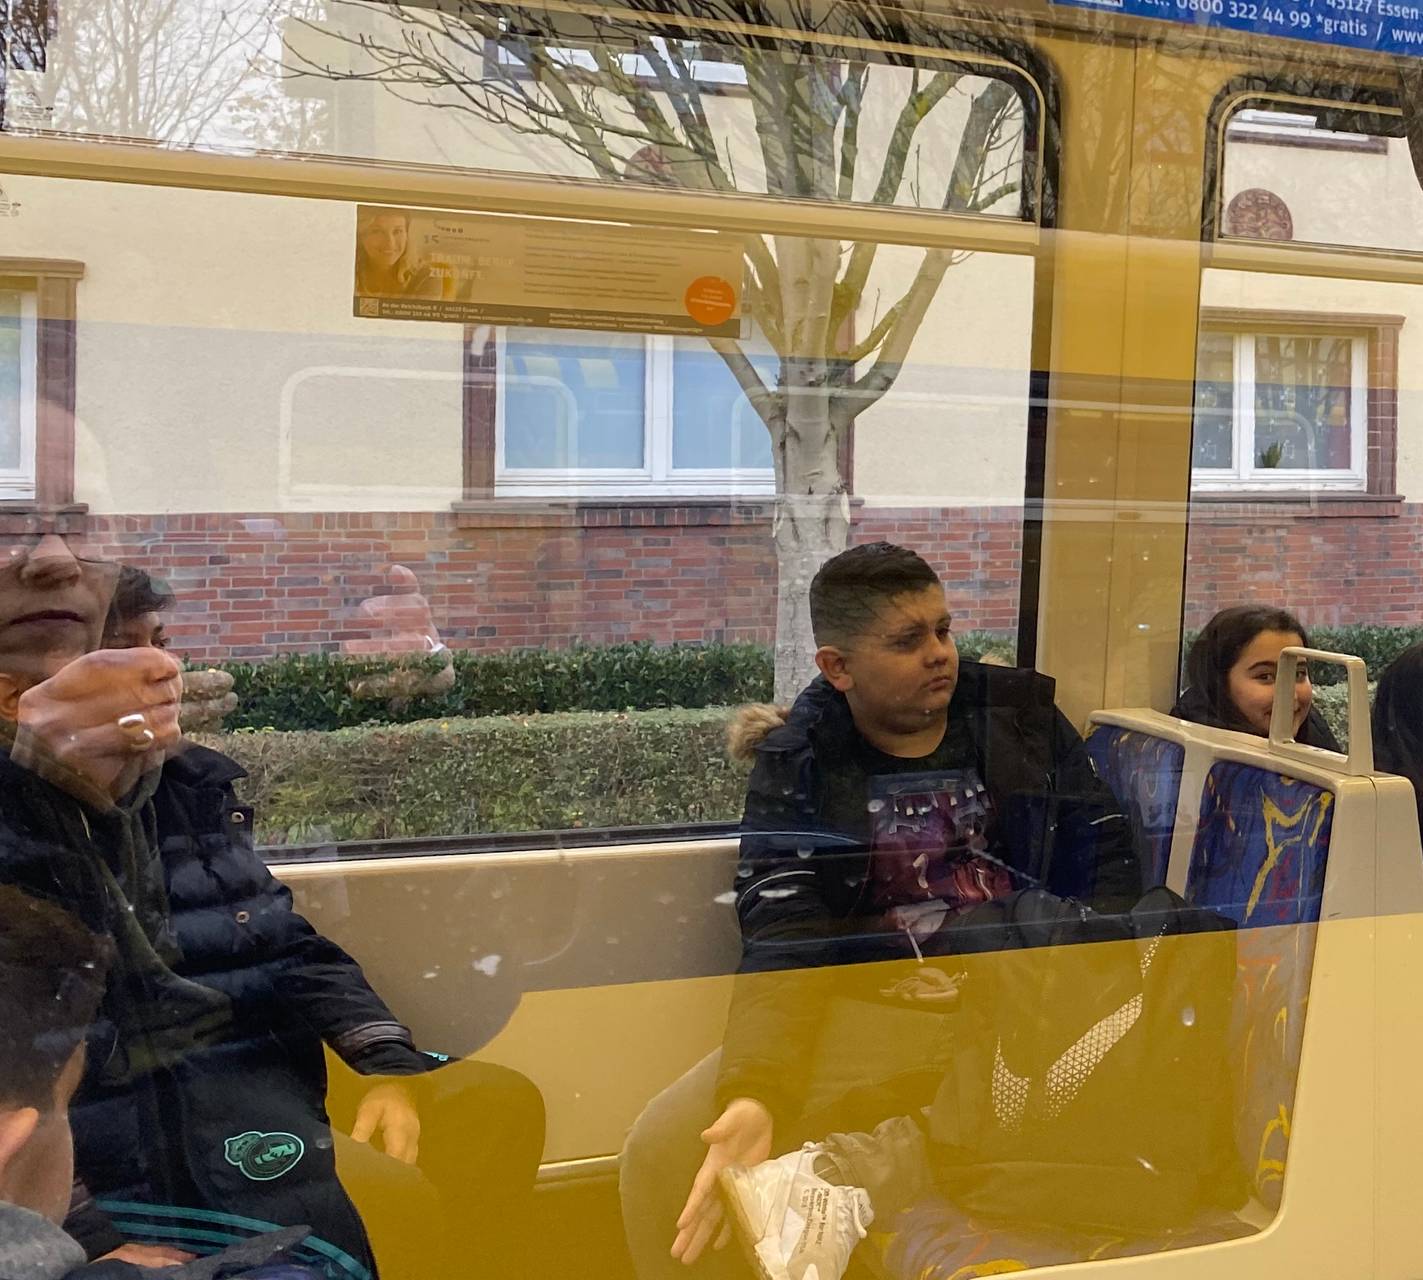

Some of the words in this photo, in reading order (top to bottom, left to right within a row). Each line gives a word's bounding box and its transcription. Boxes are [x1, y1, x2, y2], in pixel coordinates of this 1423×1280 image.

[1229, 3, 1257, 20] 322
[1263, 9, 1284, 25] 44
[1378, 1, 1419, 20] Essen
